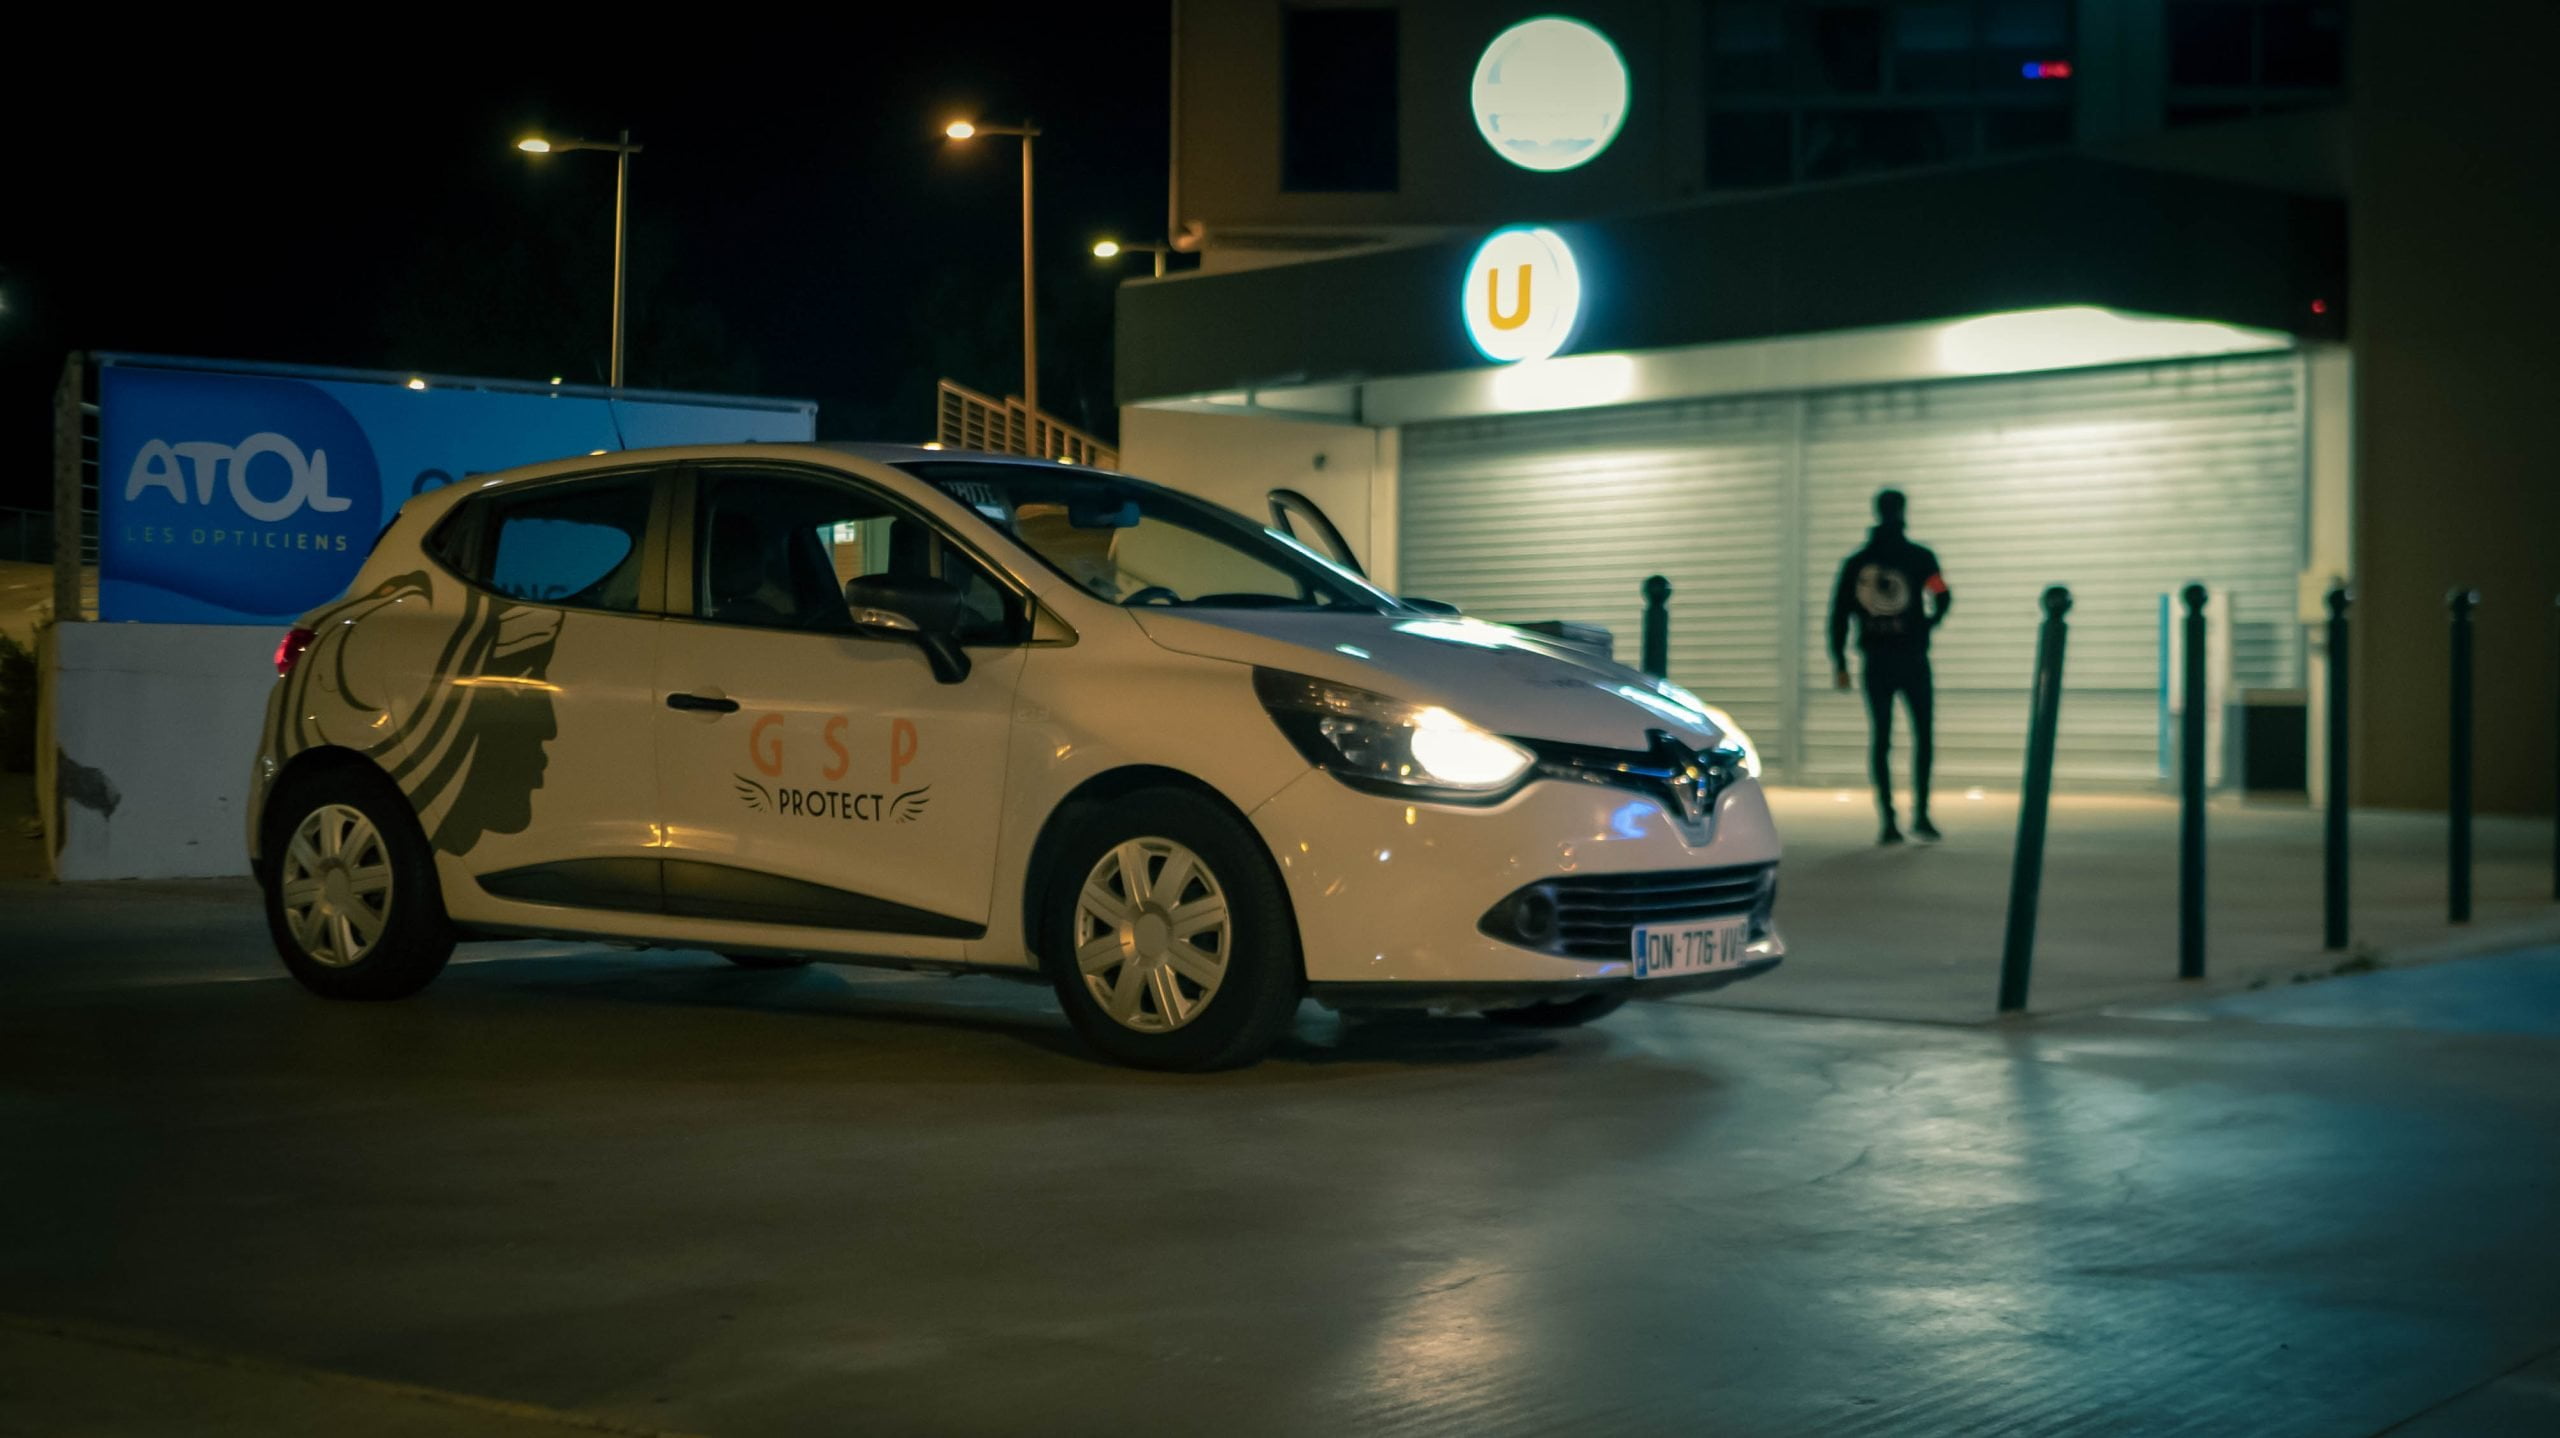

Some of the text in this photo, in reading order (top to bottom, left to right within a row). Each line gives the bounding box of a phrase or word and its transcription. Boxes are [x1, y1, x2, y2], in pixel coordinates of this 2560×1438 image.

[1488, 264, 1532, 331] U
[125, 432, 352, 522] ATOL
[127, 527, 348, 551] LES OPTICIENS
[779, 788, 884, 821] PROTECT
